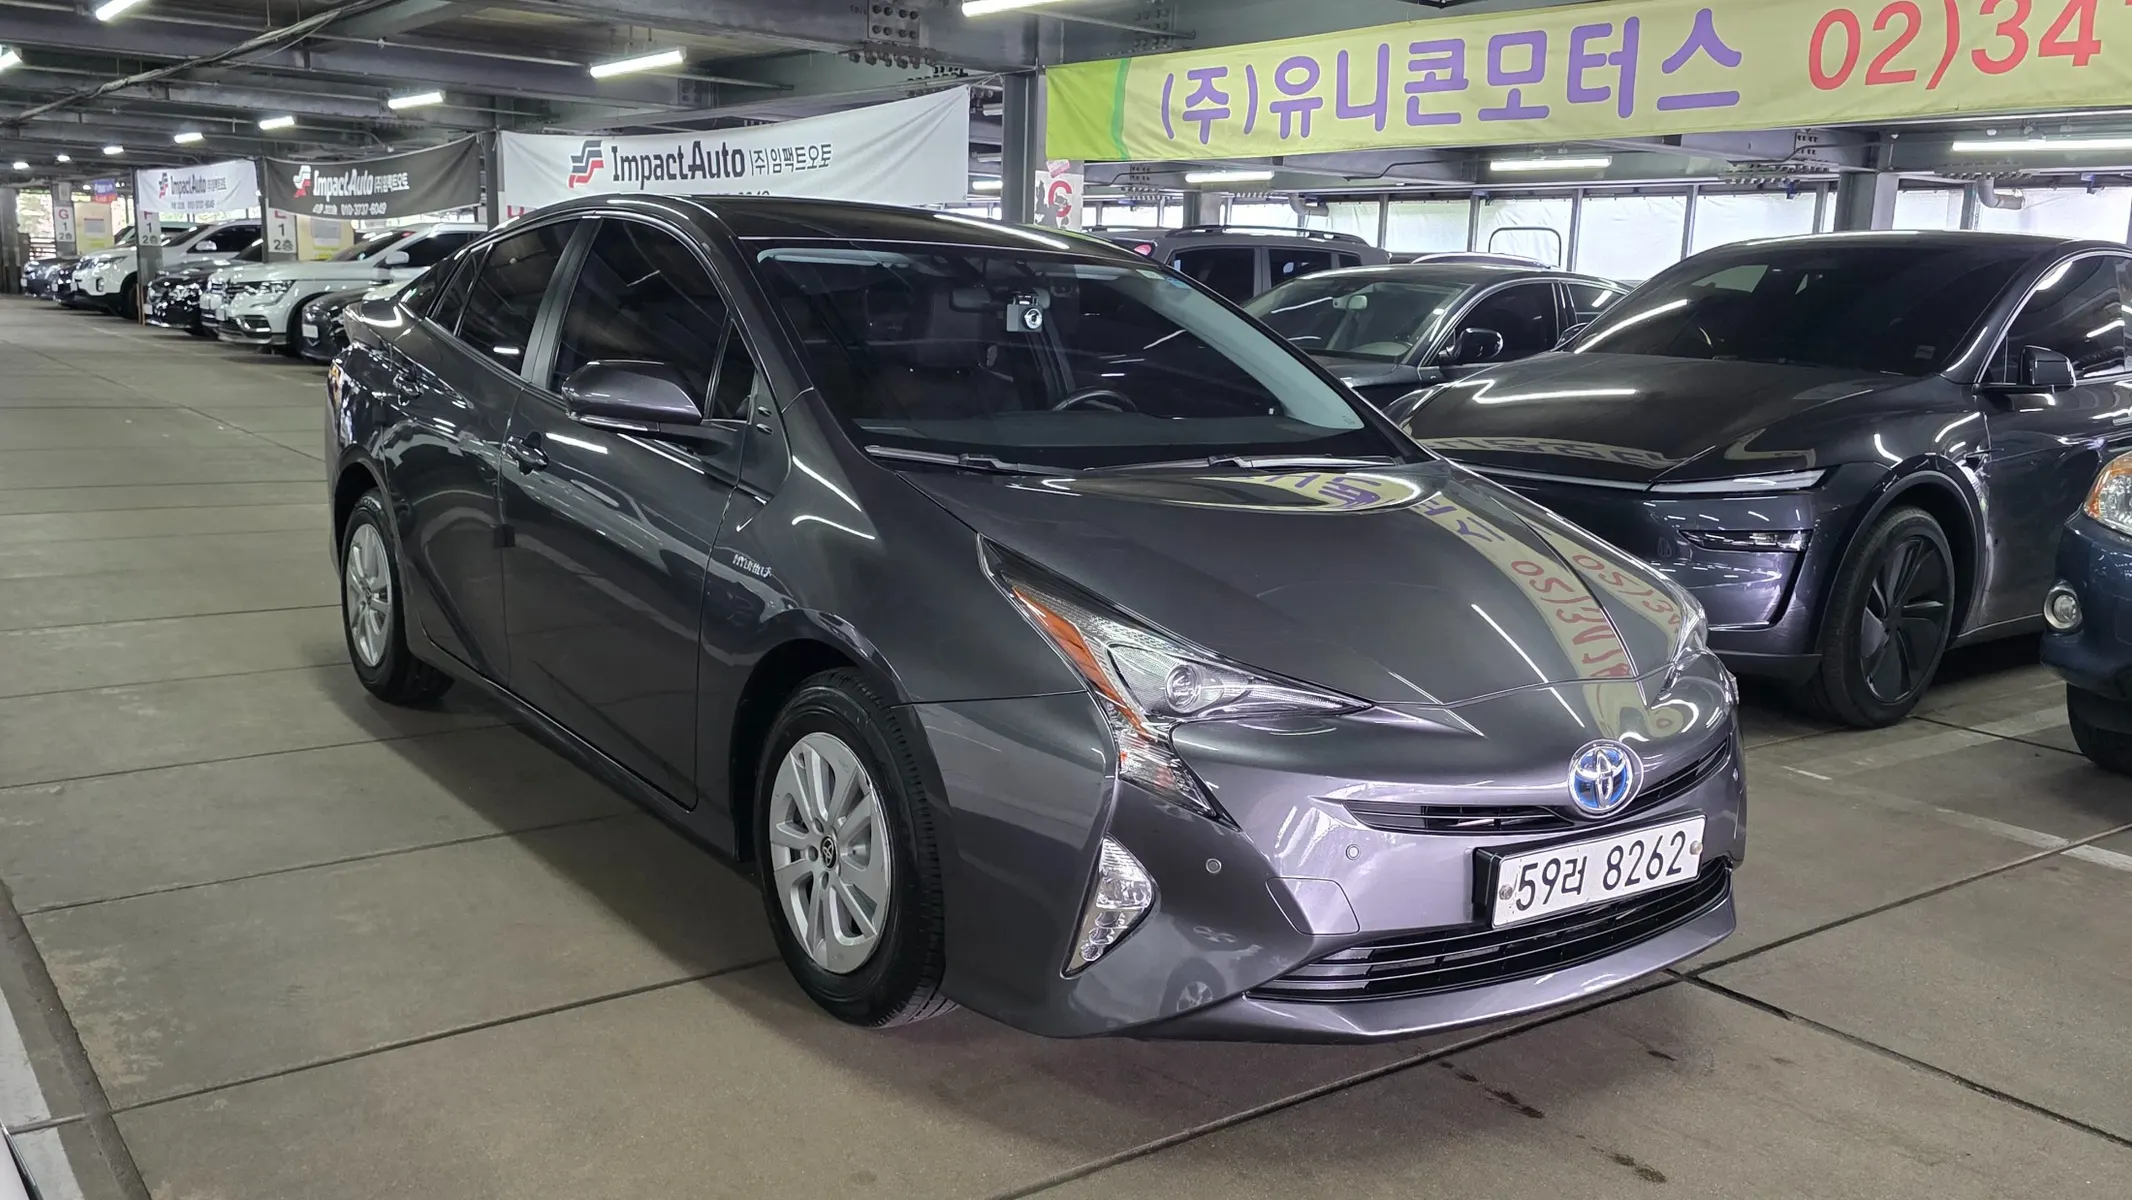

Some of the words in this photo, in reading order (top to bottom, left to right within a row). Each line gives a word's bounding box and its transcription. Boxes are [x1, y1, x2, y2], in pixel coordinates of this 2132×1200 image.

[1160, 7, 1744, 145] (주)유니콘모터스
[1808, 0, 2132, 90] 02)34
[611, 140, 746, 190] ImpactAuto
[312, 168, 374, 202] ImpactAuto
[58, 208, 70, 220] G
[146, 222, 152, 233] 1
[278, 223, 285, 236] 1
[1515, 855, 1588, 912] 59러
[1602, 830, 1687, 891] 8262
